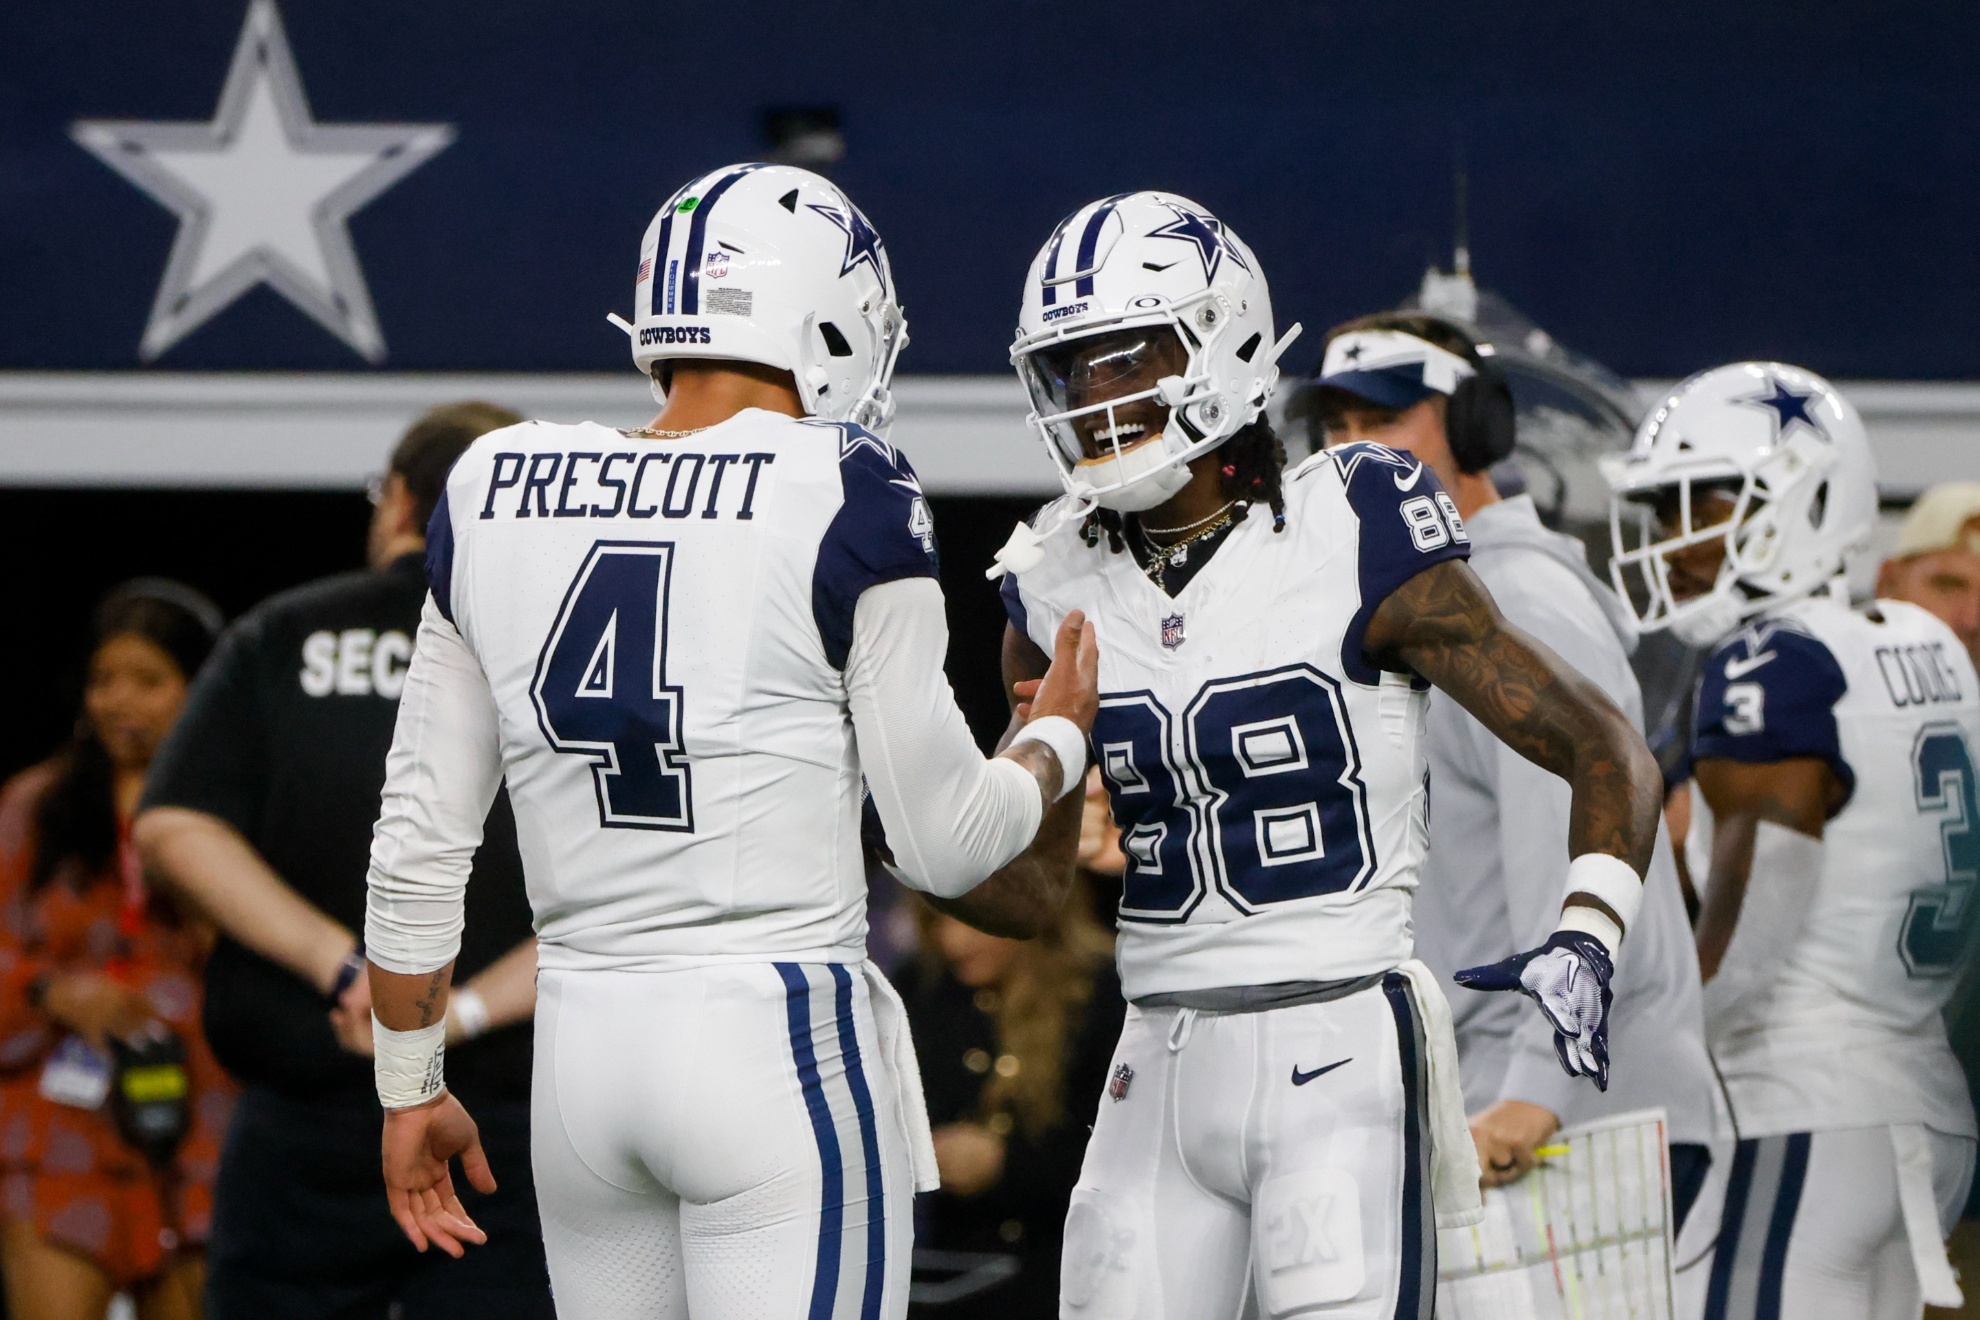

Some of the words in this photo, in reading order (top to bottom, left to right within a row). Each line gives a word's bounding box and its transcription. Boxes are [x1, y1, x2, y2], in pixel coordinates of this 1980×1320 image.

[640, 326, 711, 347] COWBOYS
[1042, 302, 1089, 322] COWBOYS
[479, 451, 776, 520] PRESCOTT
[908, 496, 934, 553] 4
[1399, 491, 1471, 553] 88
[299, 629, 412, 699] SEC
[528, 540, 695, 833] 4
[1723, 681, 1765, 735] 3
[1090, 661, 1378, 924] 88
[1896, 719, 1980, 979] 3
